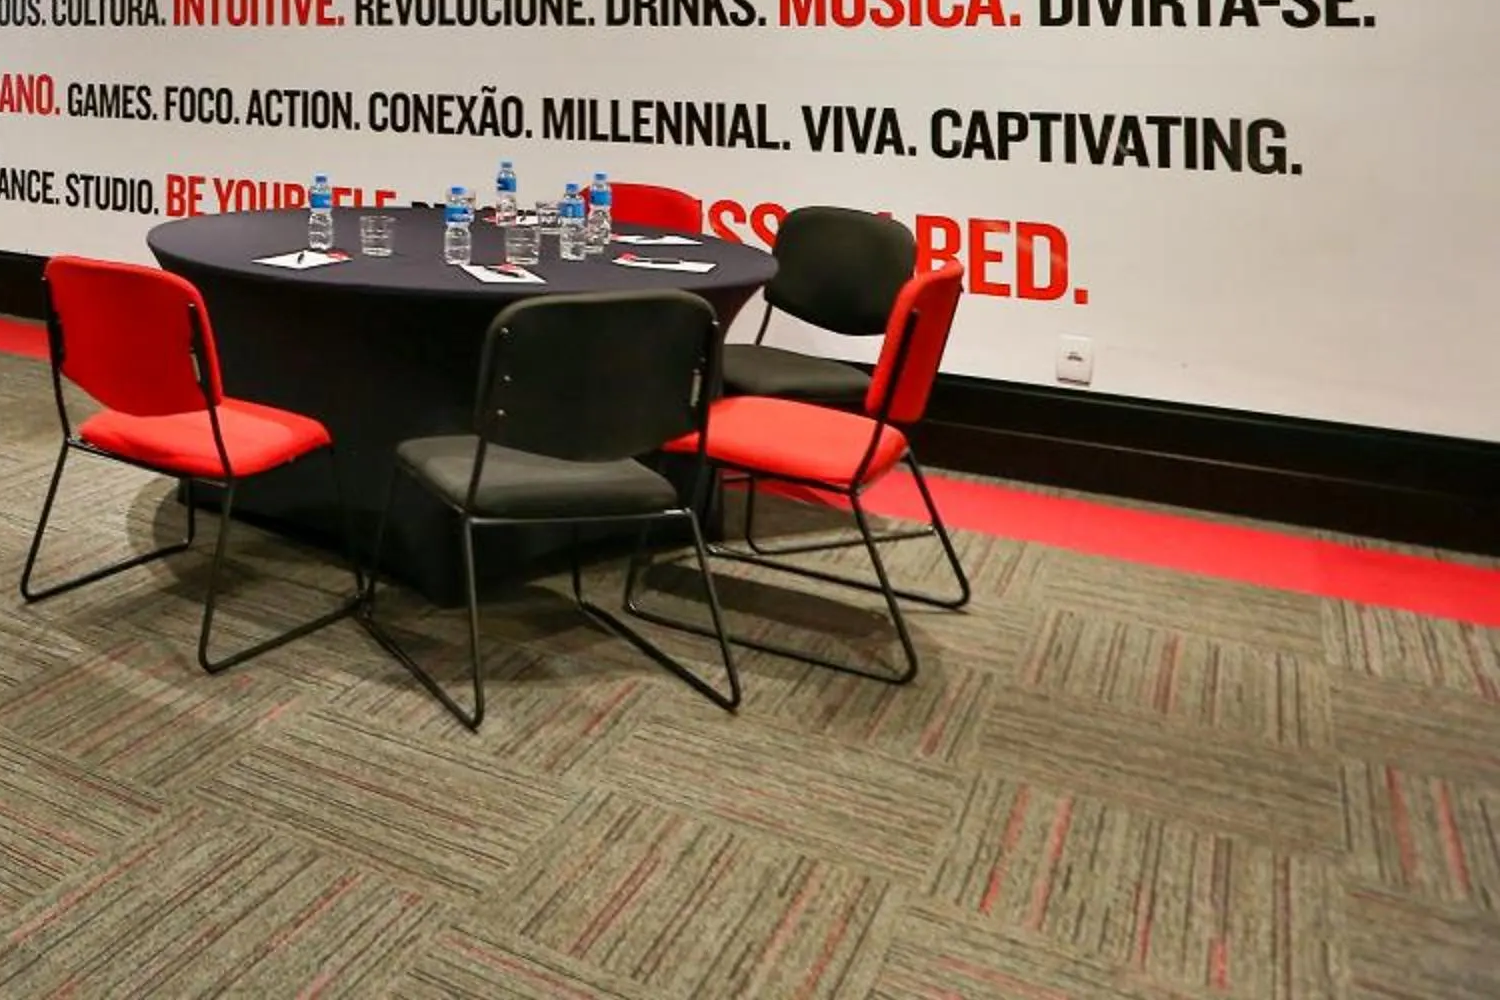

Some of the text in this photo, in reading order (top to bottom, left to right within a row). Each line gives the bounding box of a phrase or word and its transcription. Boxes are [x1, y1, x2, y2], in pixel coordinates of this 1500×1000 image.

[68, 83, 157, 120] GAMES.
[165, 86, 239, 124] FOCO.
[246, 89, 360, 130] ACTION.
[369, 86, 532, 138] CONEXÃO.
[543, 98, 790, 150] MILLENNIAL.
[802, 106, 916, 156] VIVA.
[931, 108, 1302, 175] CAPTIVATING.
[66, 173, 158, 214] STUDIO.
[167, 174, 205, 217] BE
